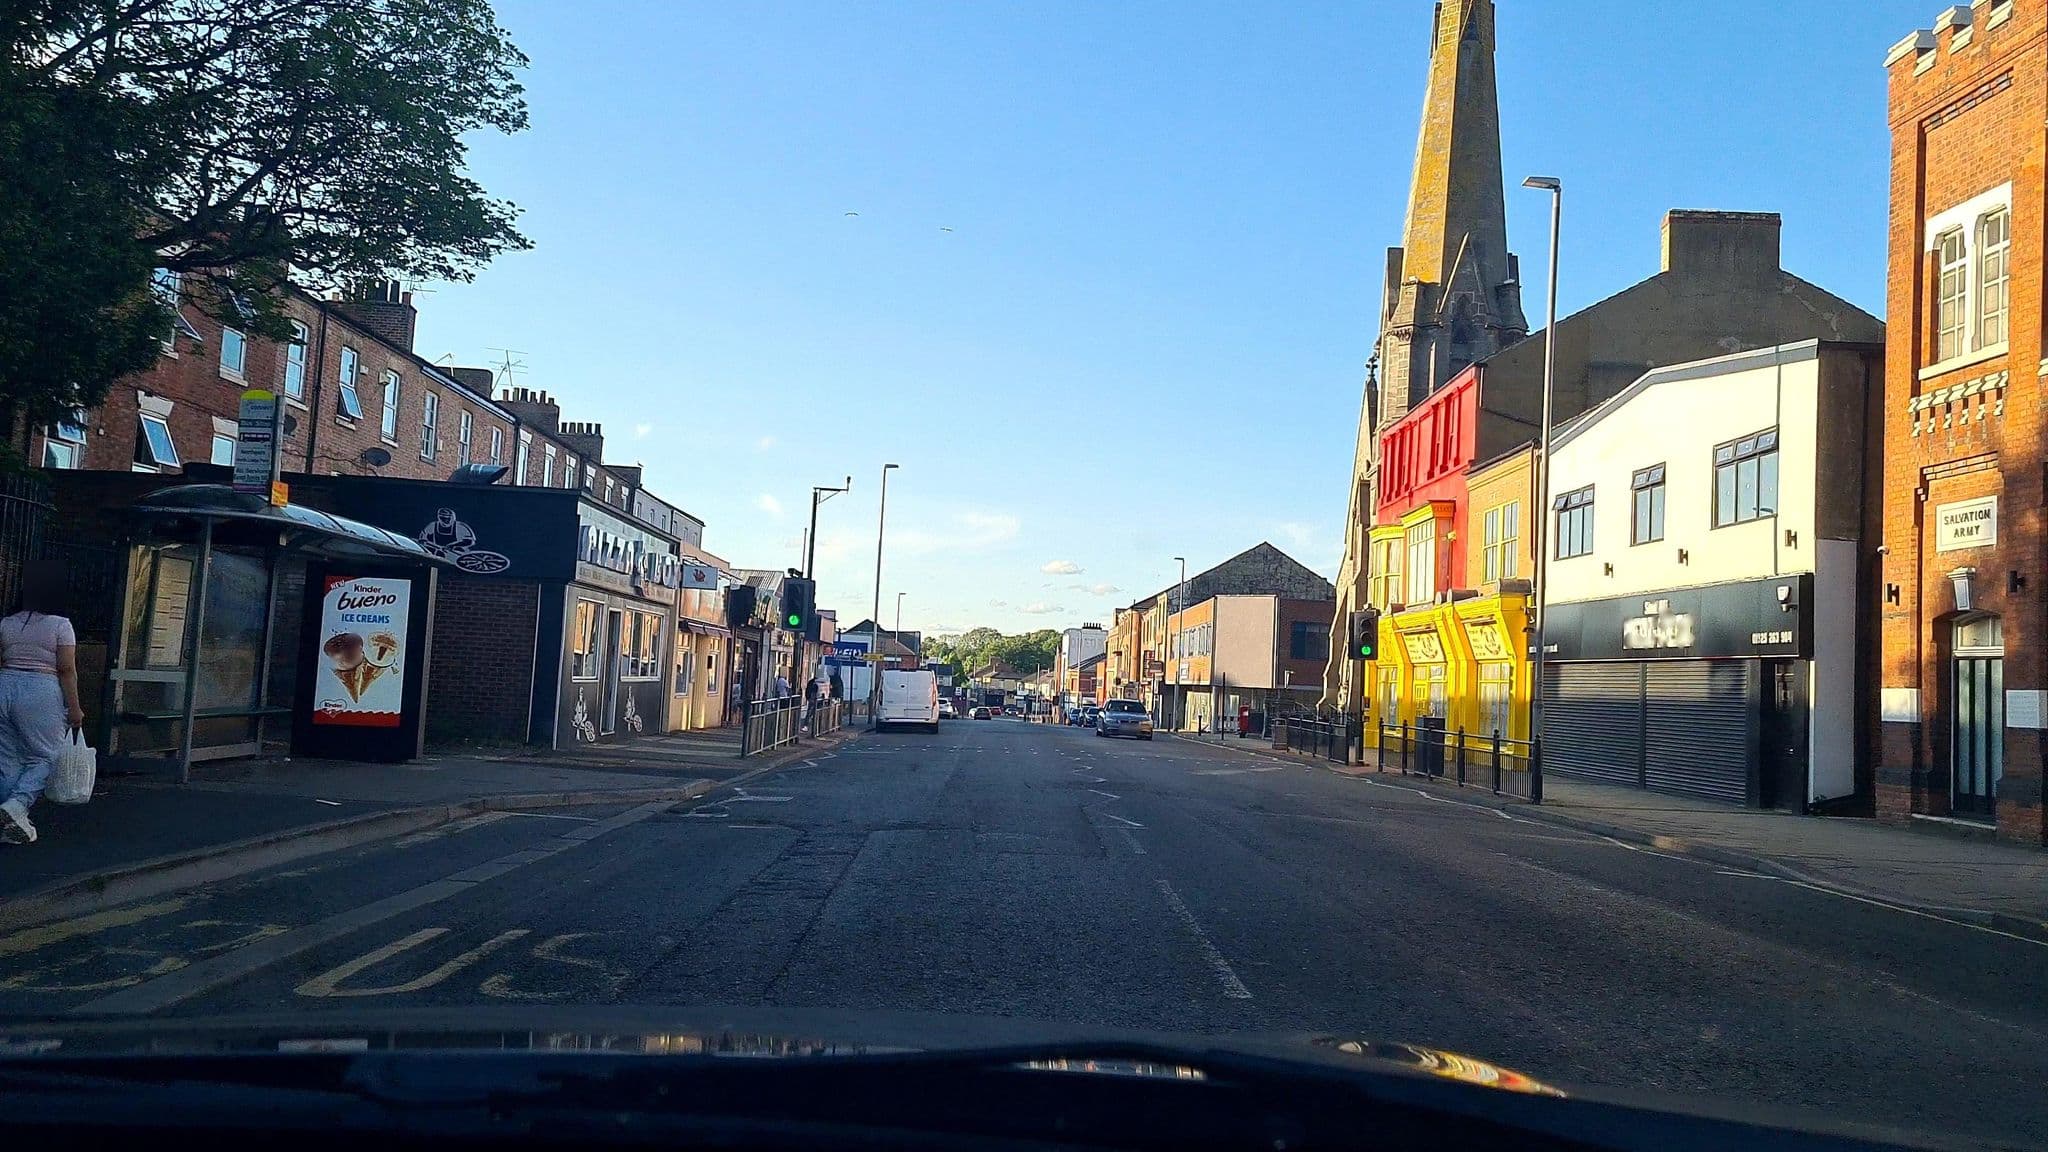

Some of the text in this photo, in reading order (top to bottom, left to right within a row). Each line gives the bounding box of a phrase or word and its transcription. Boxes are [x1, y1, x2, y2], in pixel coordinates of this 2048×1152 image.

[1944, 508, 1991, 525] SALVATION
[1953, 525, 1980, 538] ARMY
[337, 592, 397, 611] bueno
[341, 613, 390, 624] ICE CREAMS
